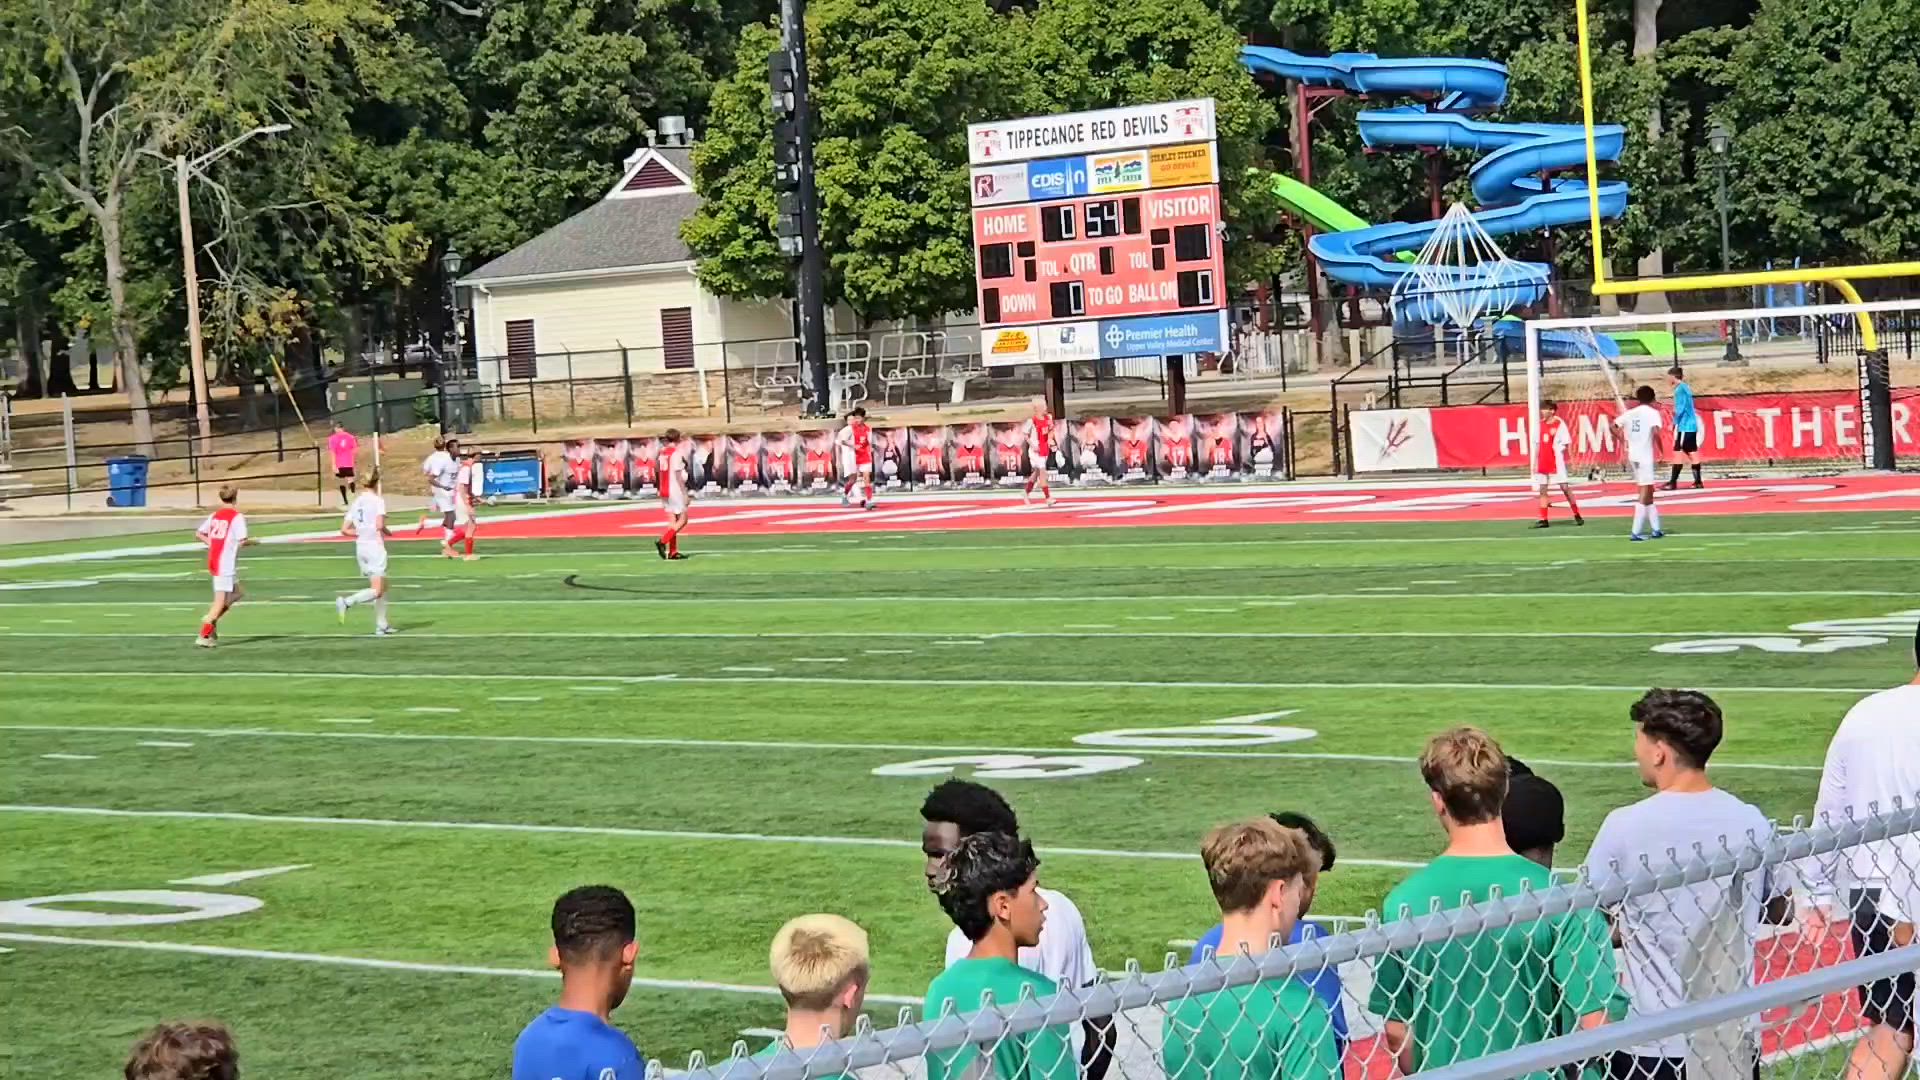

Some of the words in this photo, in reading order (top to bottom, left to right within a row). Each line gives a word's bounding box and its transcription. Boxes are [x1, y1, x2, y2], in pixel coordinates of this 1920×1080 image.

[1006, 123, 1084, 150] TIPPECANOE
[1091, 120, 1116, 141] RED
[1123, 113, 1169, 138] DEVILS
[1150, 195, 1211, 219] VISITOR
[983, 214, 1028, 236] HOME
[1085, 201, 1120, 237] 54
[1041, 260, 1060, 277] TOL
[1069, 252, 1097, 275] QTR
[1128, 252, 1149, 269] TOL
[1088, 287, 1103, 306] TO
[1105, 285, 1123, 305] GO
[1128, 282, 1159, 304] BALL
[1160, 280, 1177, 300] ON
[1002, 294, 1037, 313] DOWN
[1125, 327, 1163, 341] Premier
[1164, 323, 1198, 338] Health
[1166, 337, 1191, 347] Medical
[1191, 337, 1214, 345] Center
[1756, 405, 1857, 448] THE
